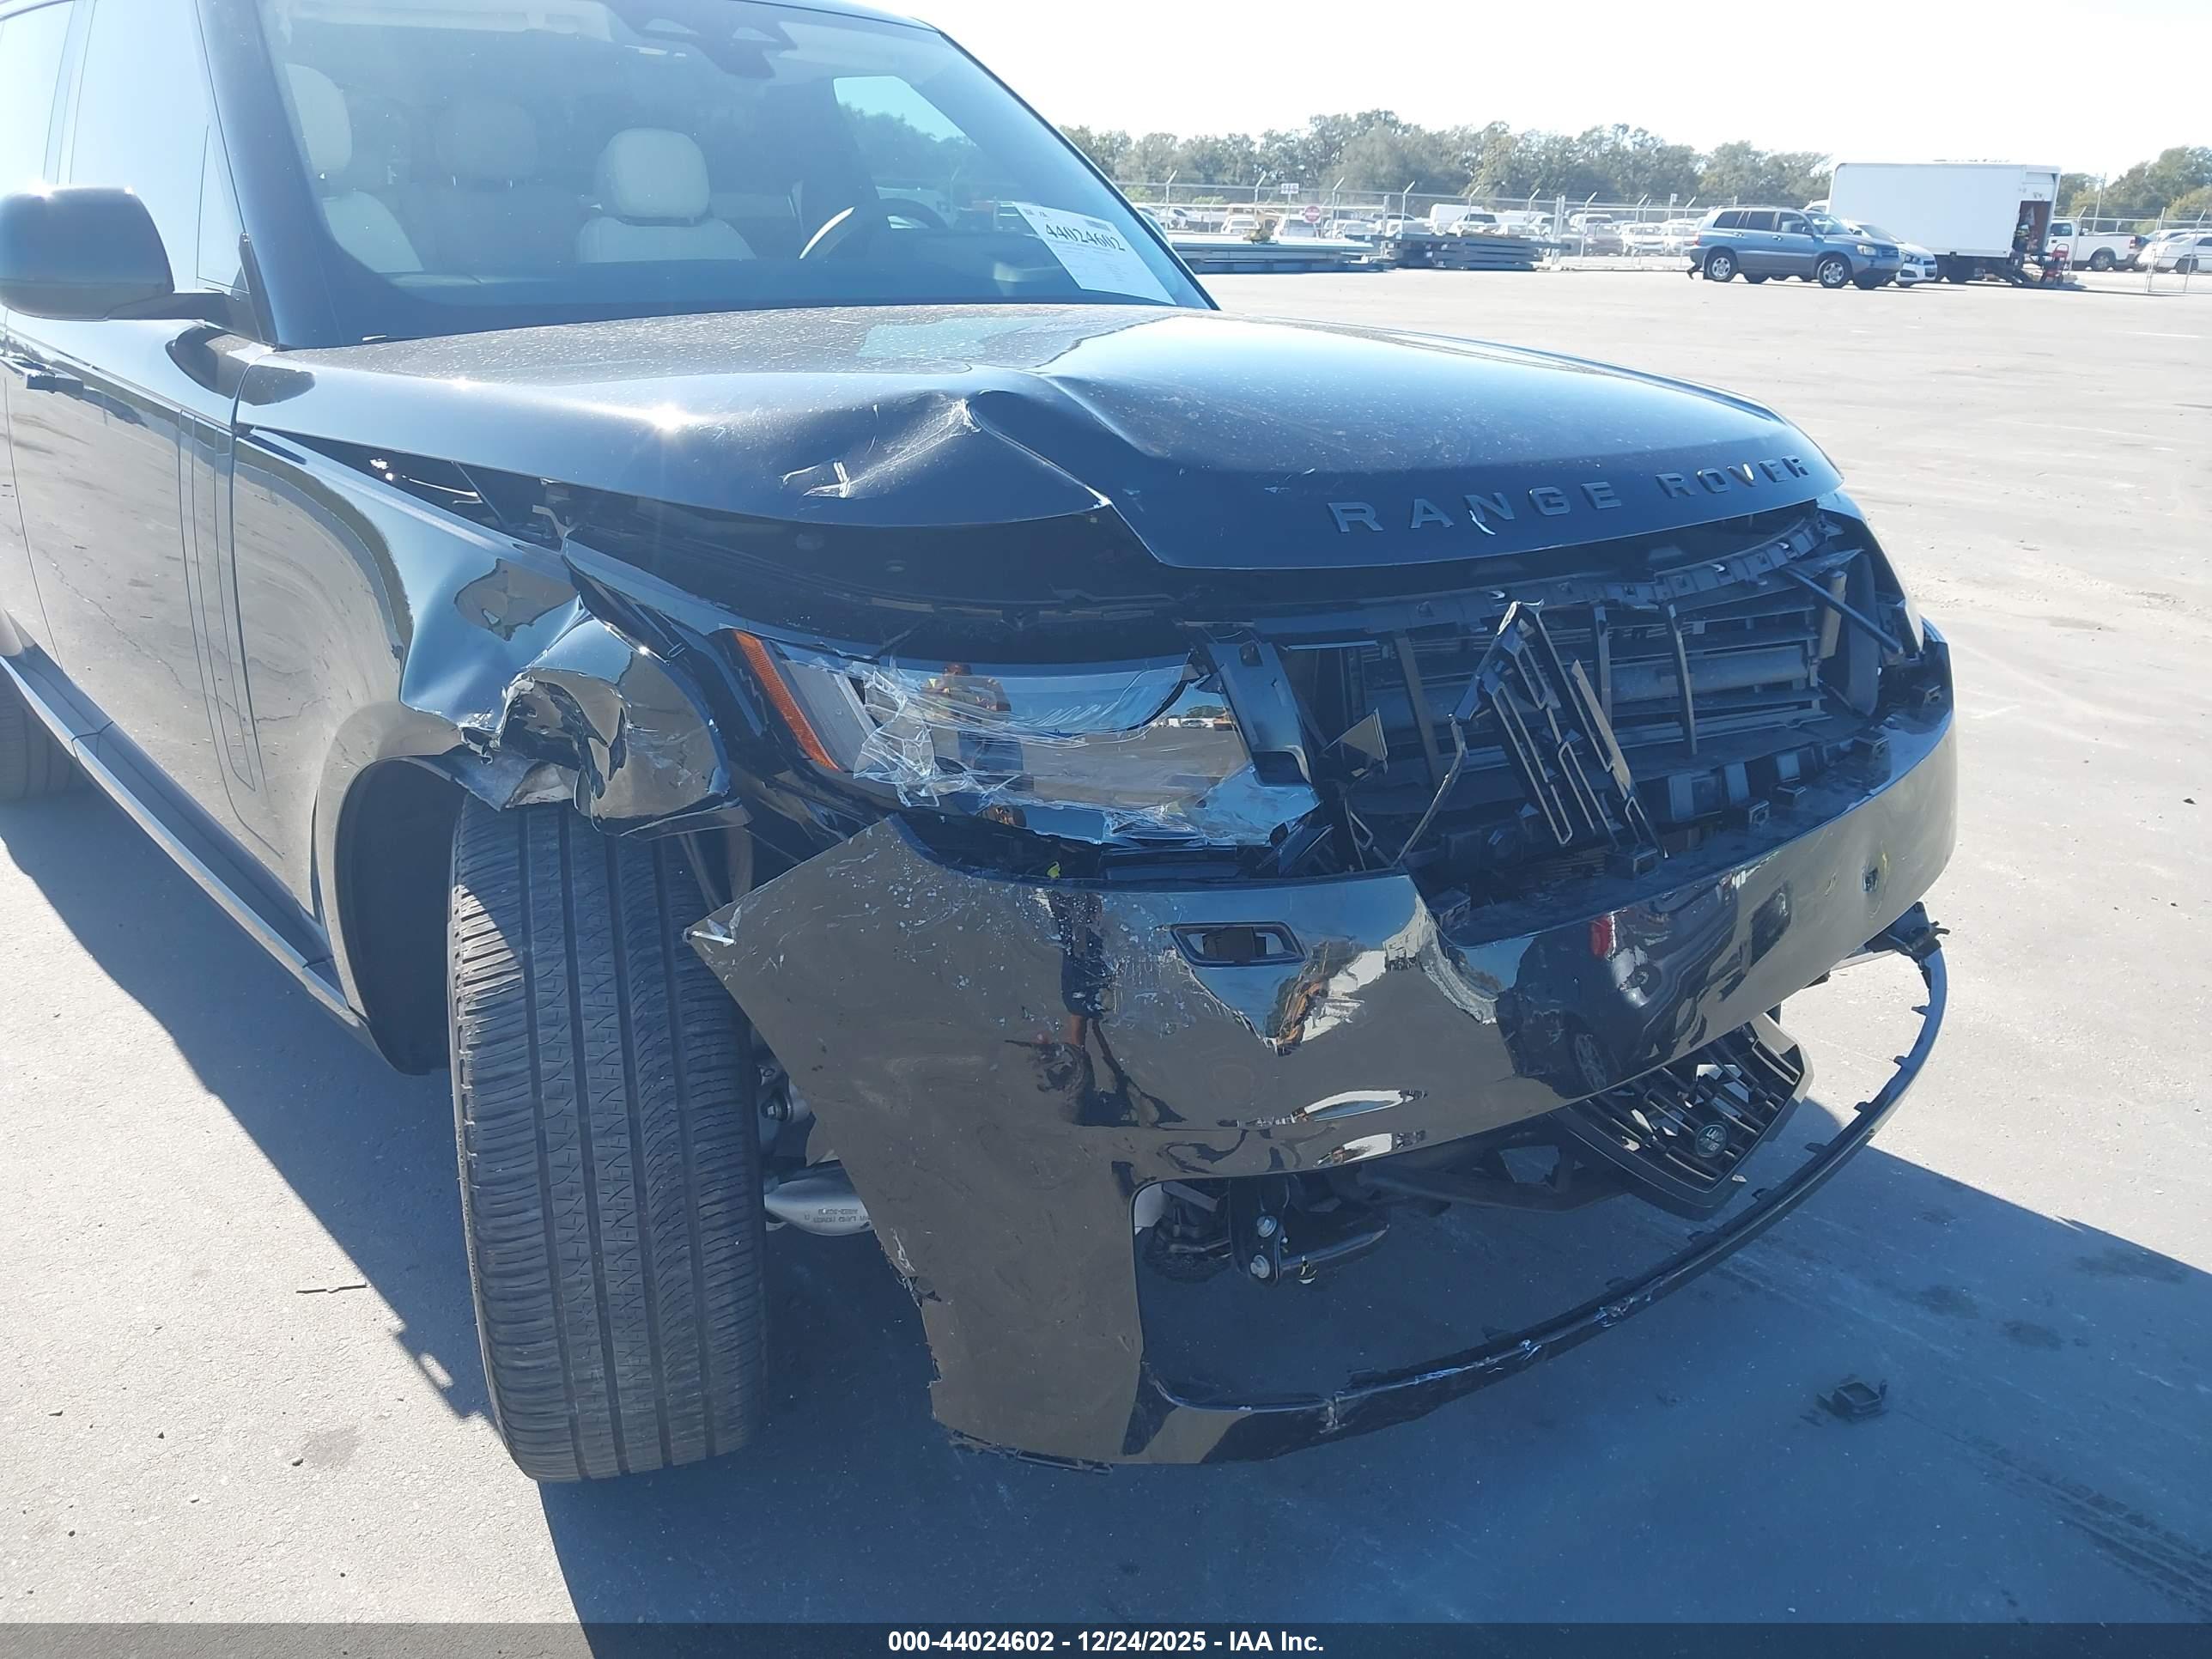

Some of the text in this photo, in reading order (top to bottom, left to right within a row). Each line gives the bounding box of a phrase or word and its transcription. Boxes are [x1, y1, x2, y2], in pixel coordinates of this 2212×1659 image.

[1046, 223, 1126, 252] 44024602
[1327, 454, 1809, 532] RANGE ROVER
